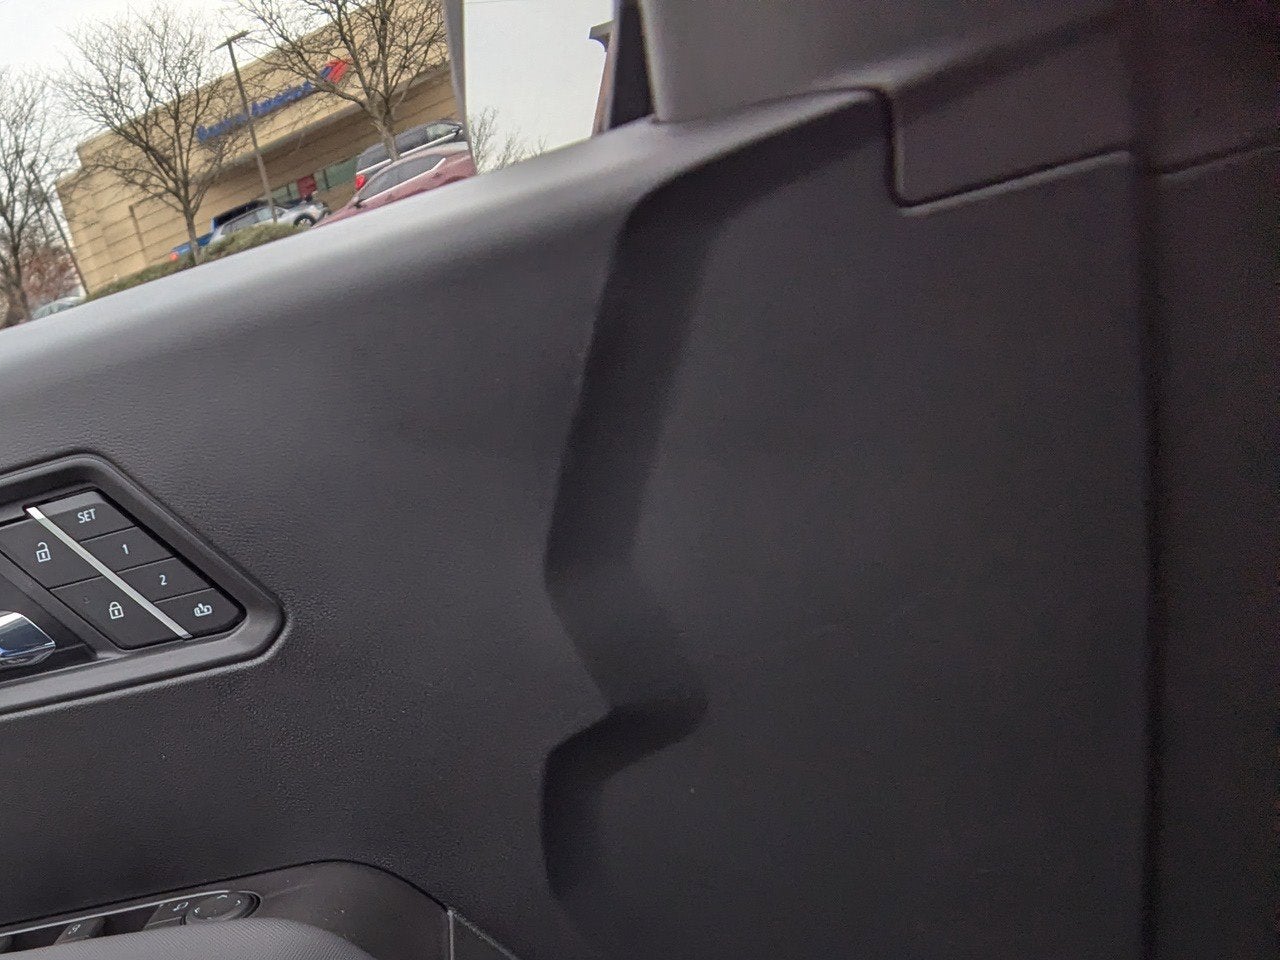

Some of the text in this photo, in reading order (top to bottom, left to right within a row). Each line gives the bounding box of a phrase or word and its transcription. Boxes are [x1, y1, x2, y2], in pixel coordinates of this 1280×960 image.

[77, 508, 96, 523] SET
[122, 543, 130, 555] 1
[159, 574, 168, 586] 2
